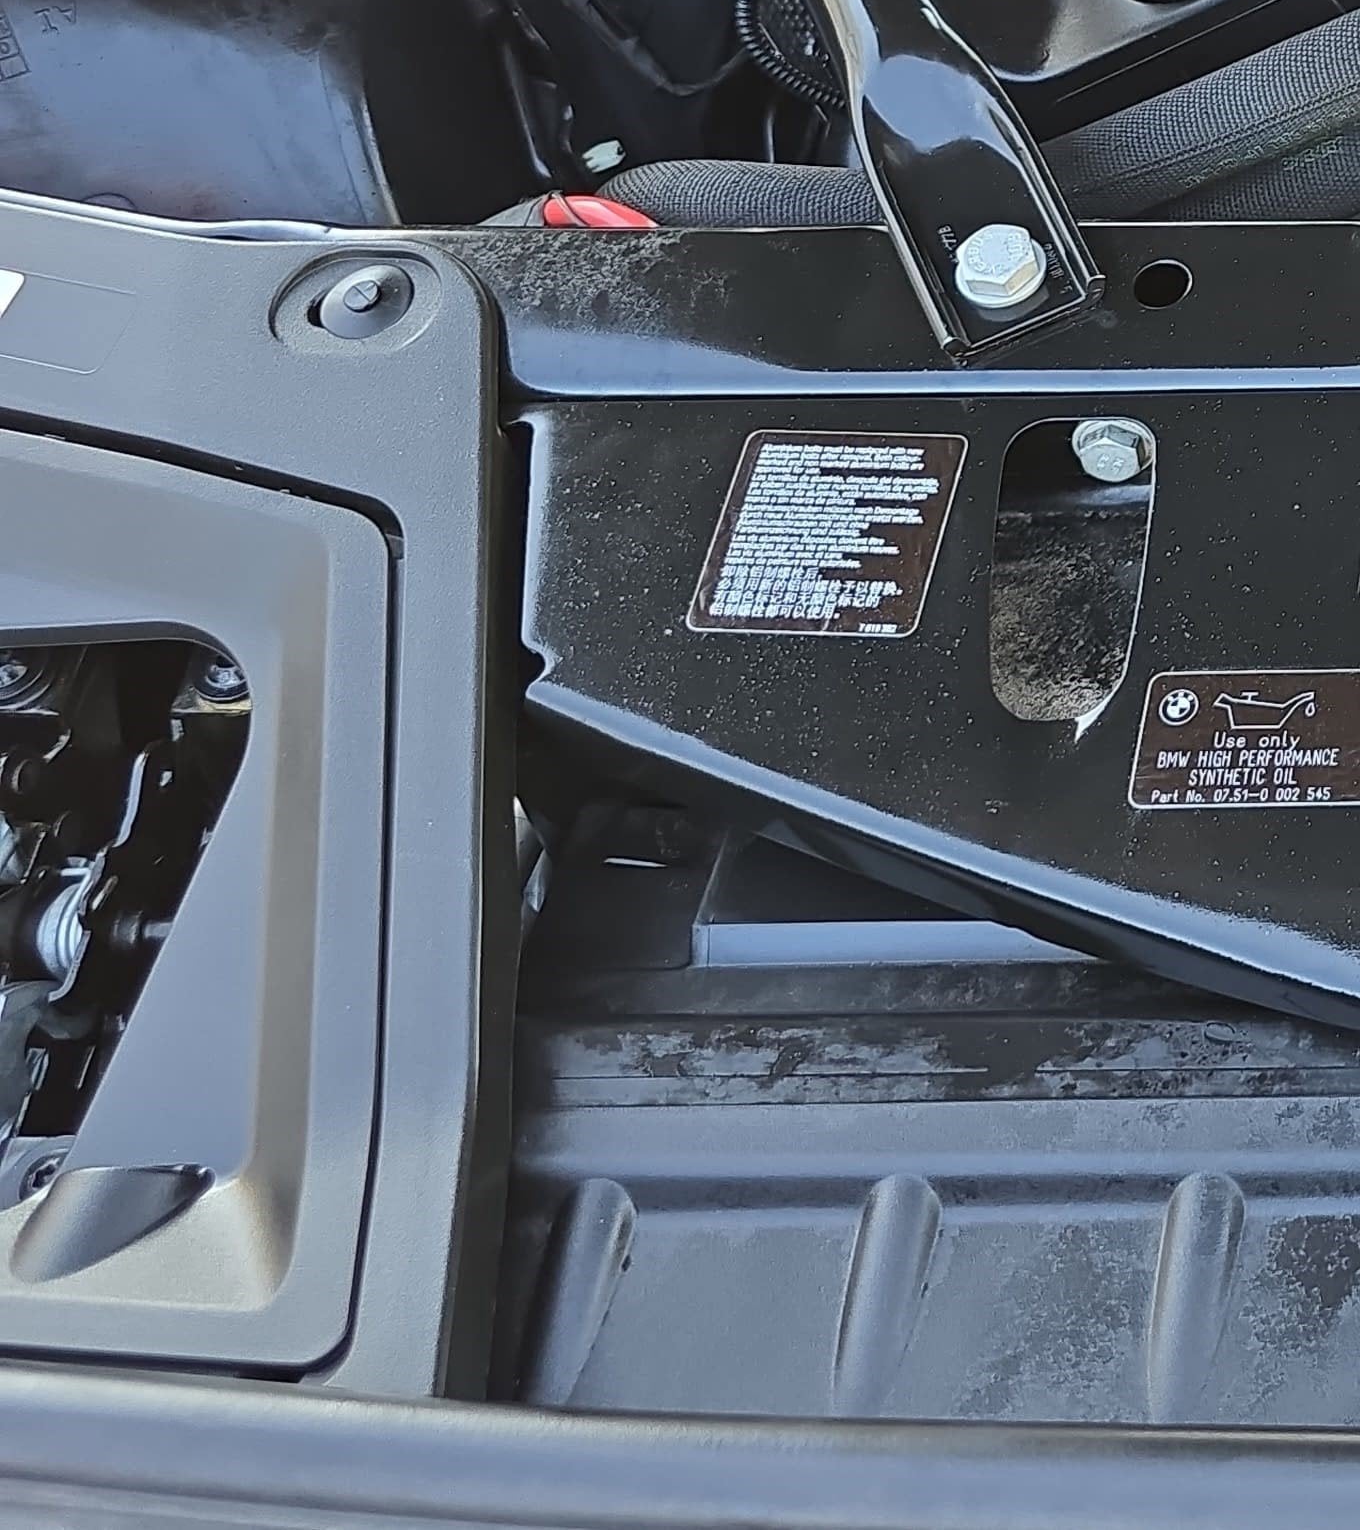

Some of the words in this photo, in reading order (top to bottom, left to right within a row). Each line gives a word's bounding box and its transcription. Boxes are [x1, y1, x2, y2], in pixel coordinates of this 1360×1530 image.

[1213, 731, 1246, 749] Use
[1258, 730, 1300, 752] only
[1157, 750, 1191, 769] BMW
[1197, 749, 1232, 768] HIGH
[1238, 748, 1340, 767] PERFORMANCE
[1188, 768, 1267, 786] SYNTHETIC
[1273, 767, 1297, 785] OIL
[1151, 789, 1178, 803] Part
[1185, 789, 1206, 803] No.
[1213, 788, 1269, 802] 07.51-0
[1275, 787, 1300, 802] 002
[1306, 786, 1332, 801] 545
